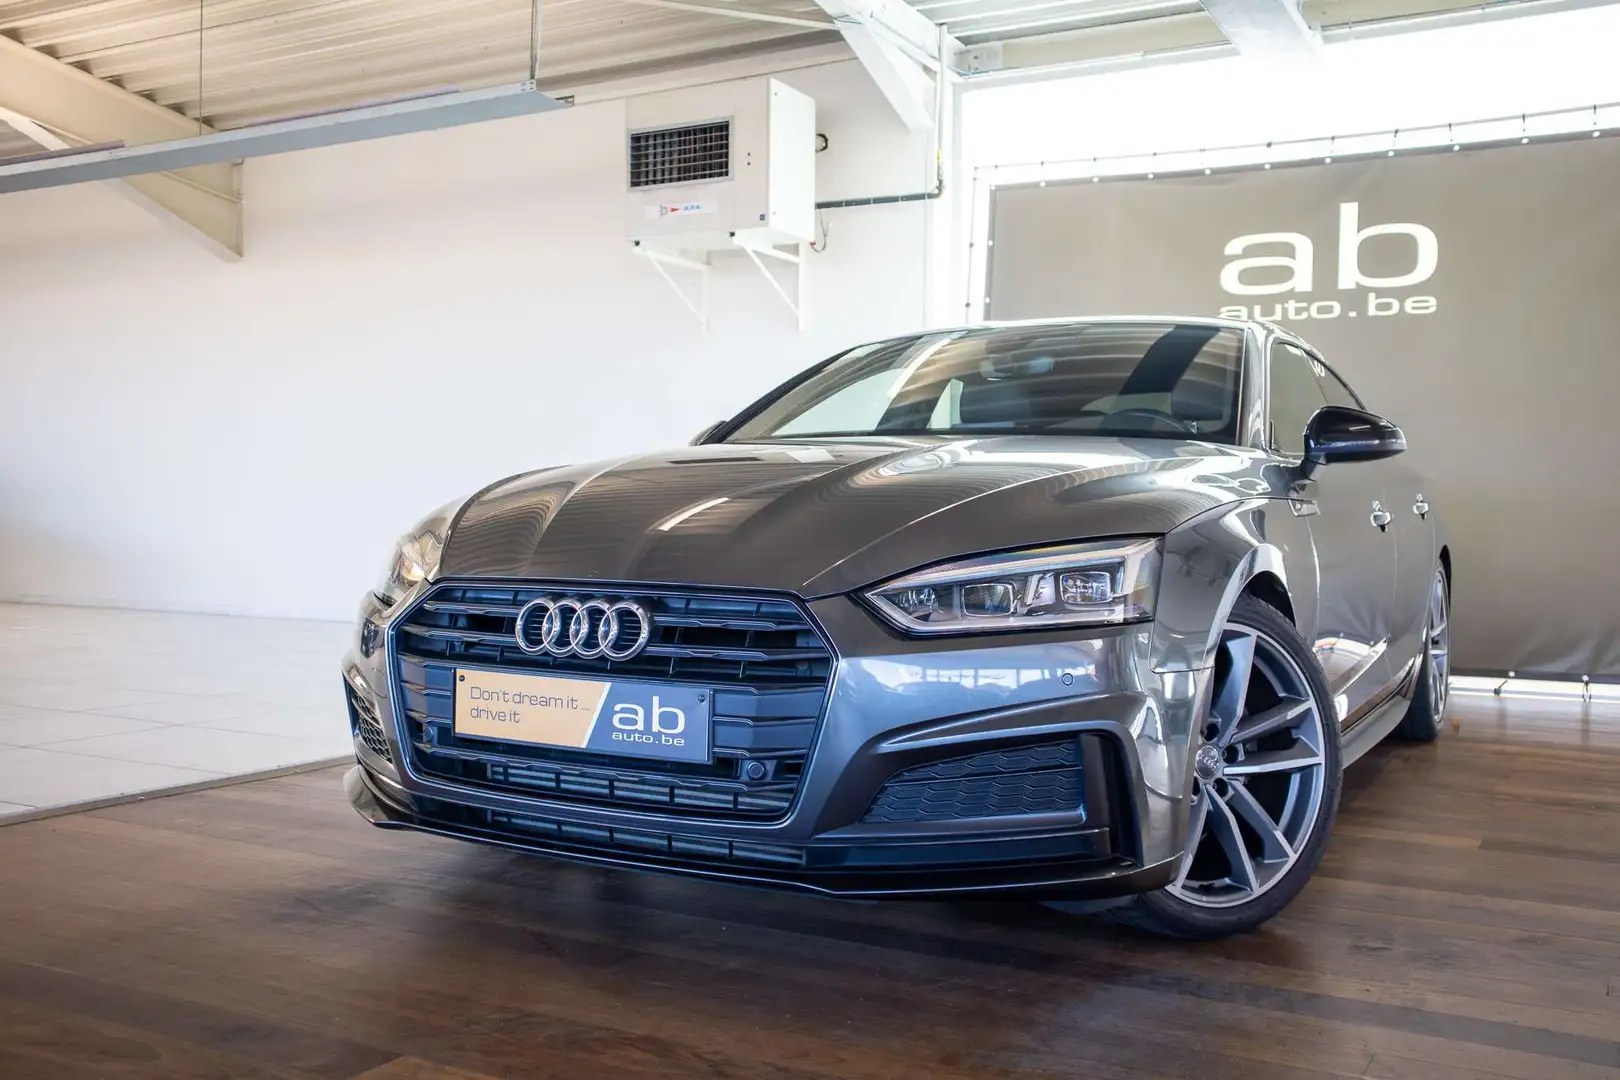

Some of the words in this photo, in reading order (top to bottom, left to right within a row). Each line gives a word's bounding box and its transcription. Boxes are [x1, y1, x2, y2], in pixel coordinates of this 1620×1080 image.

[1219, 201, 1439, 295] ab
[1218, 292, 1438, 321] auto.be
[470, 686, 510, 703] Don't
[512, 691, 562, 708] dream
[470, 706, 506, 722] drive
[508, 710, 520, 723] it
[612, 696, 686, 734] ab
[612, 731, 685, 746] auto.be
